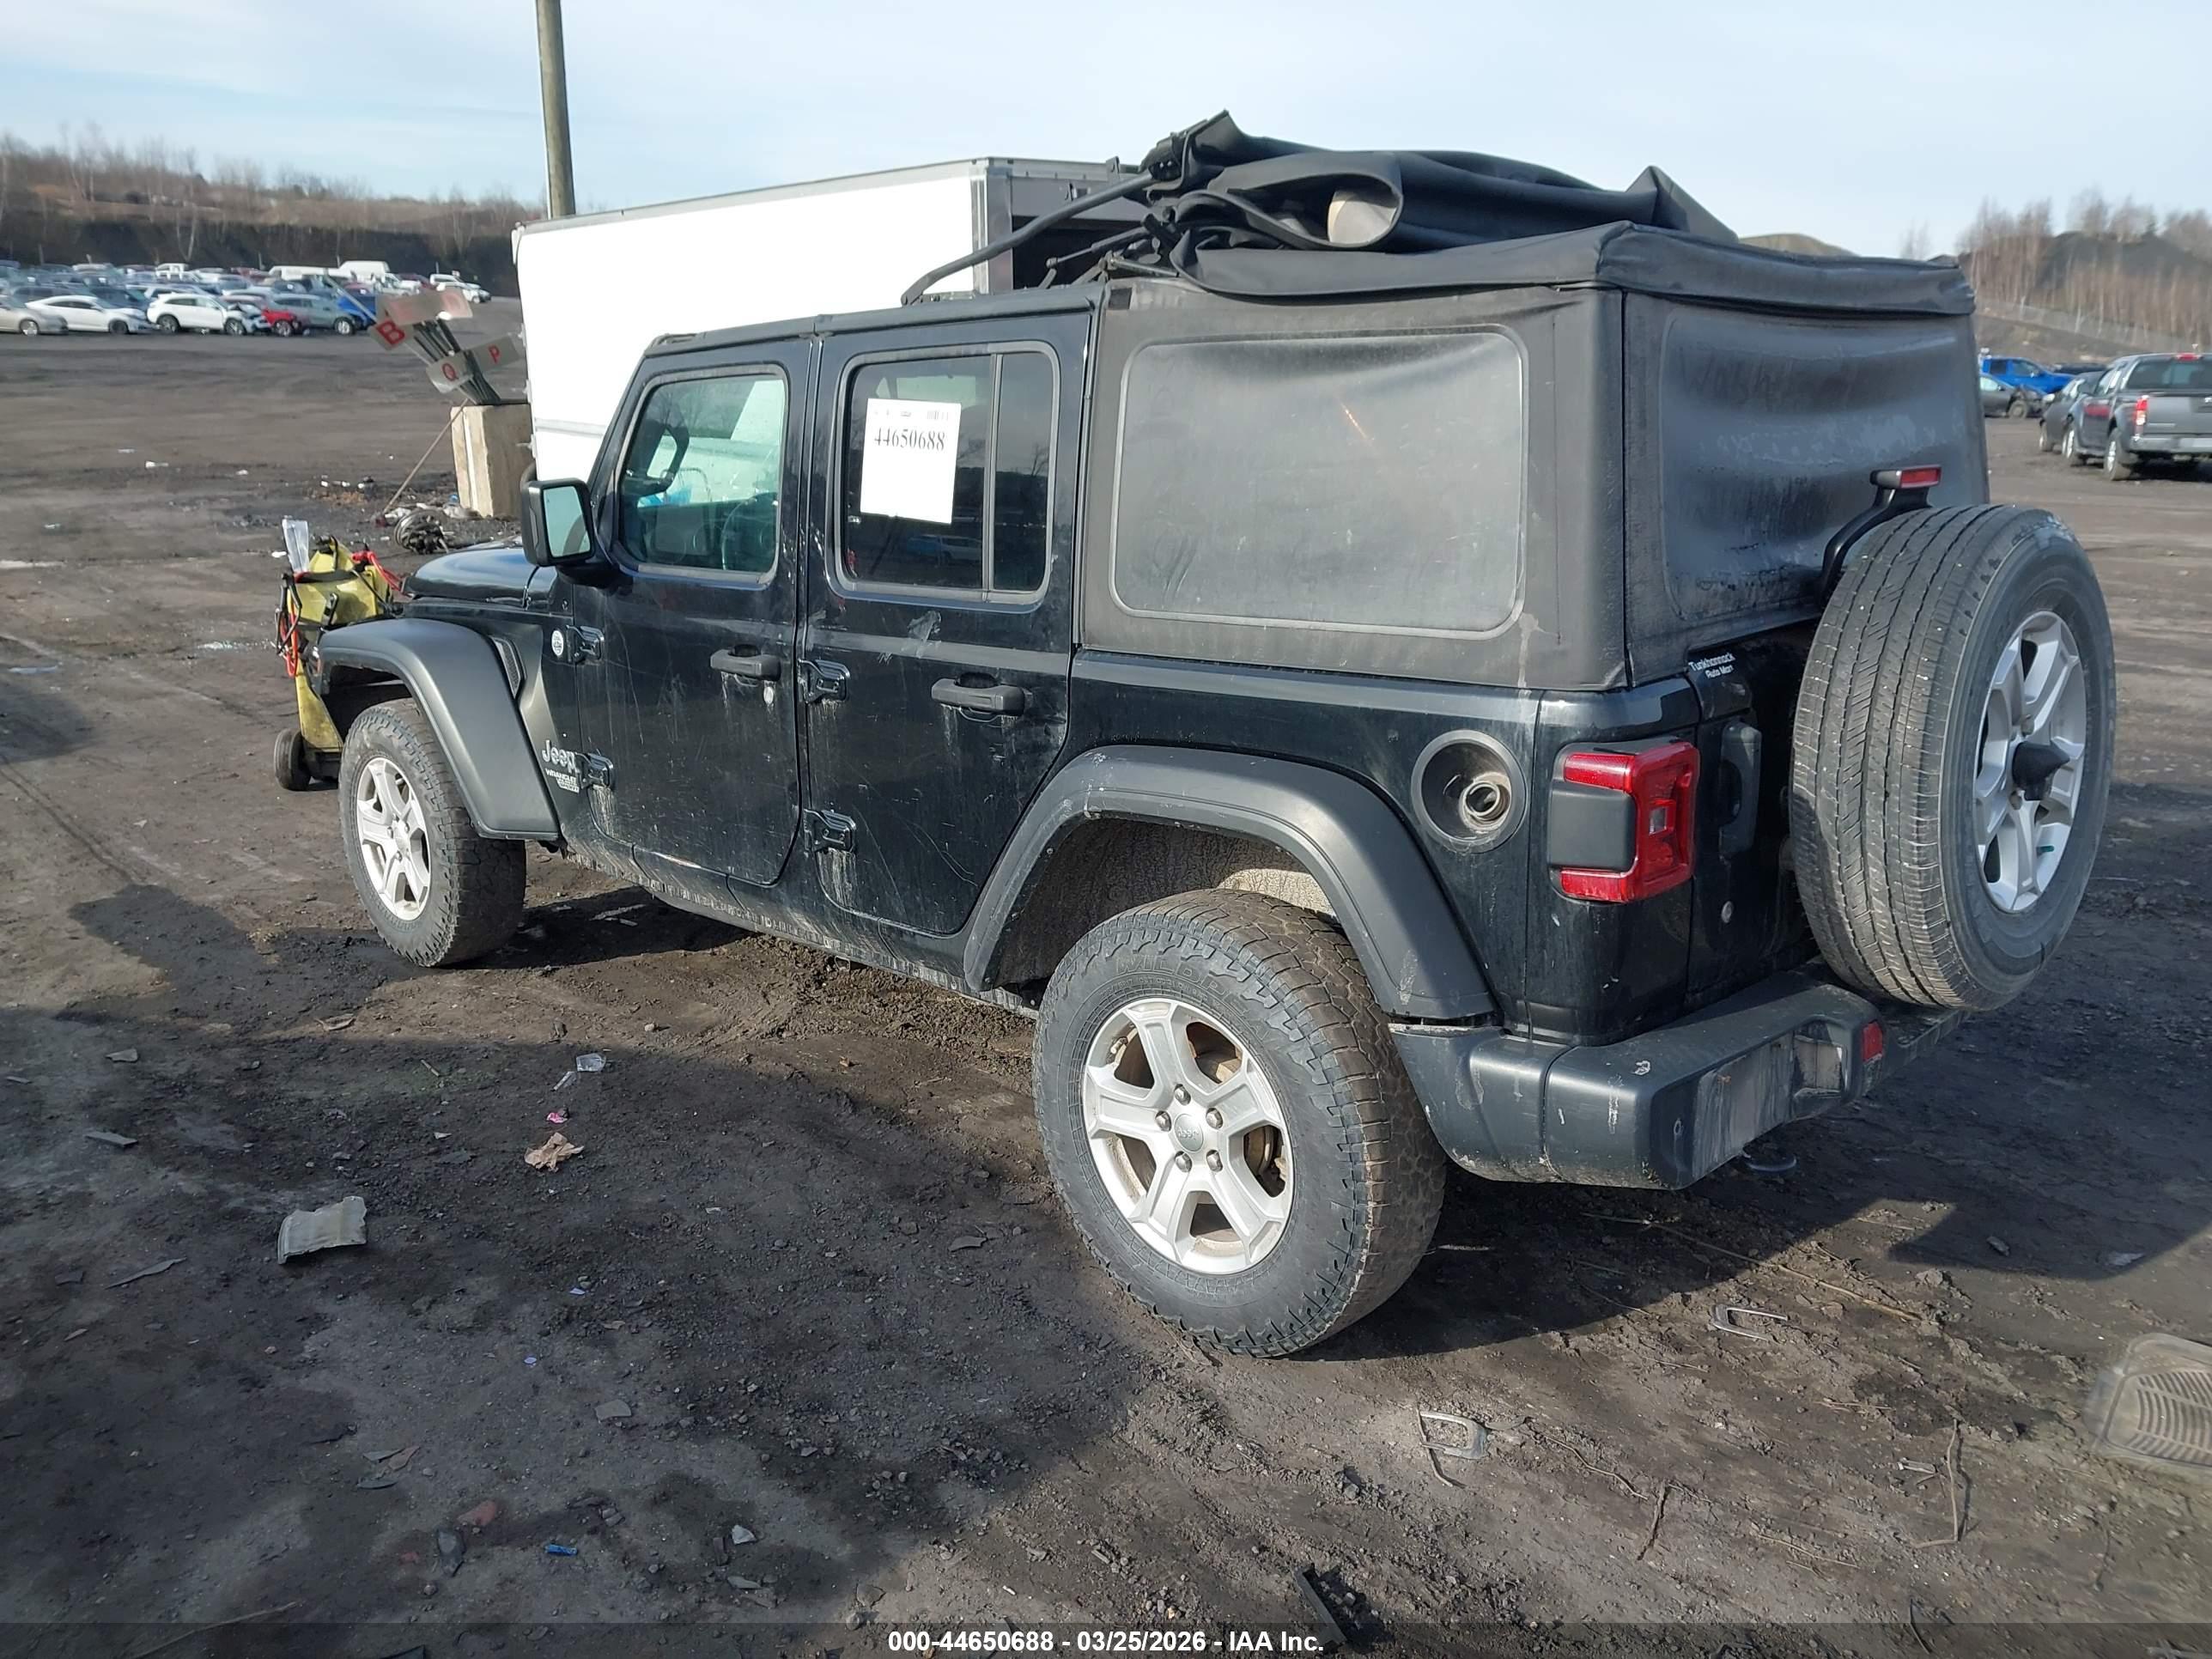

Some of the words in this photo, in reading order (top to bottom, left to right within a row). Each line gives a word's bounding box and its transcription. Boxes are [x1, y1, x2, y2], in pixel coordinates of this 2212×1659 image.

[376, 320, 405, 345] B
[488, 344, 501, 364] P
[441, 362, 459, 382] Q
[874, 427, 945, 453] 44650688
[542, 740, 580, 774] Jeep
